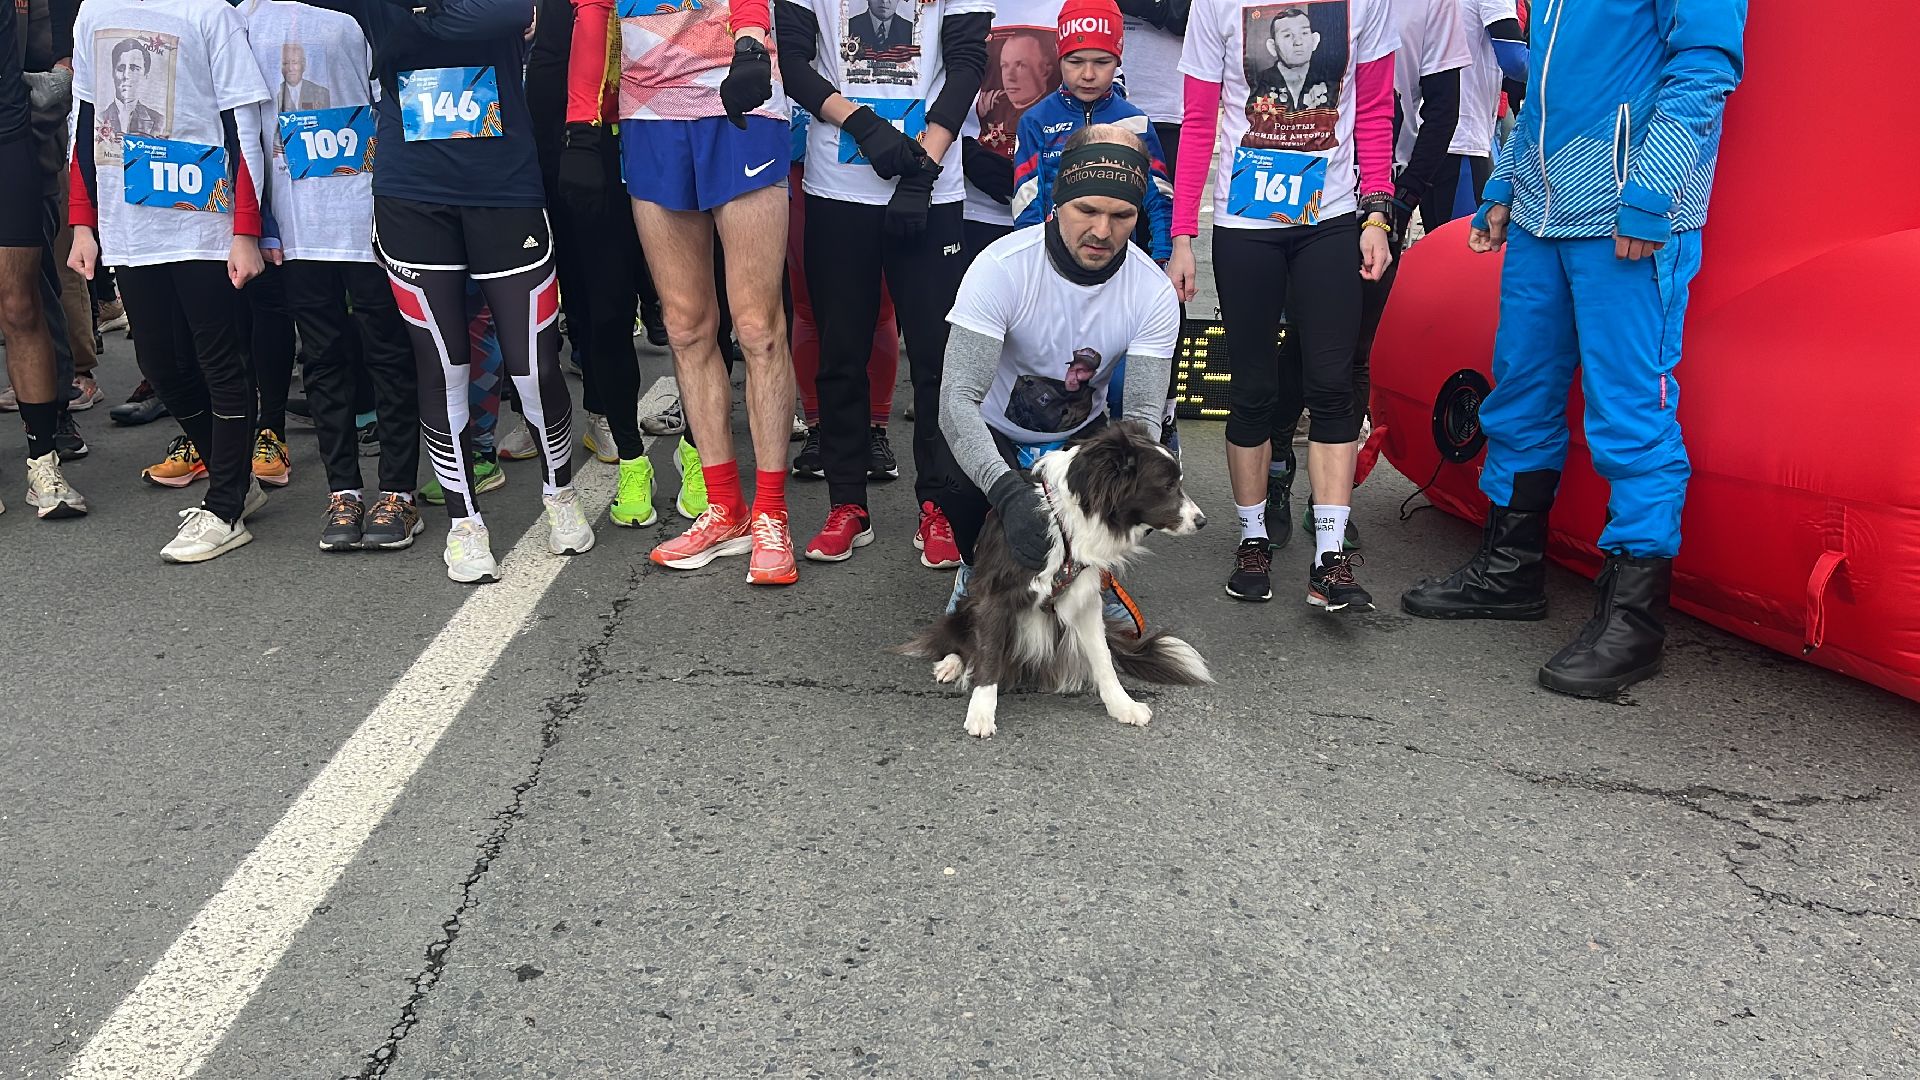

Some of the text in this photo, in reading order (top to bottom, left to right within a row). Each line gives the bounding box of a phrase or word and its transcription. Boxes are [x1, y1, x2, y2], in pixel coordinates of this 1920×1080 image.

[1058, 18, 1111, 41] LUKOIL
[418, 91, 480, 123] 146
[300, 127, 358, 160] 109
[150, 161, 203, 194] 110
[1065, 169, 1127, 185] Vottovaara
[1254, 170, 1303, 206] 161
[943, 241, 961, 256] FILA
